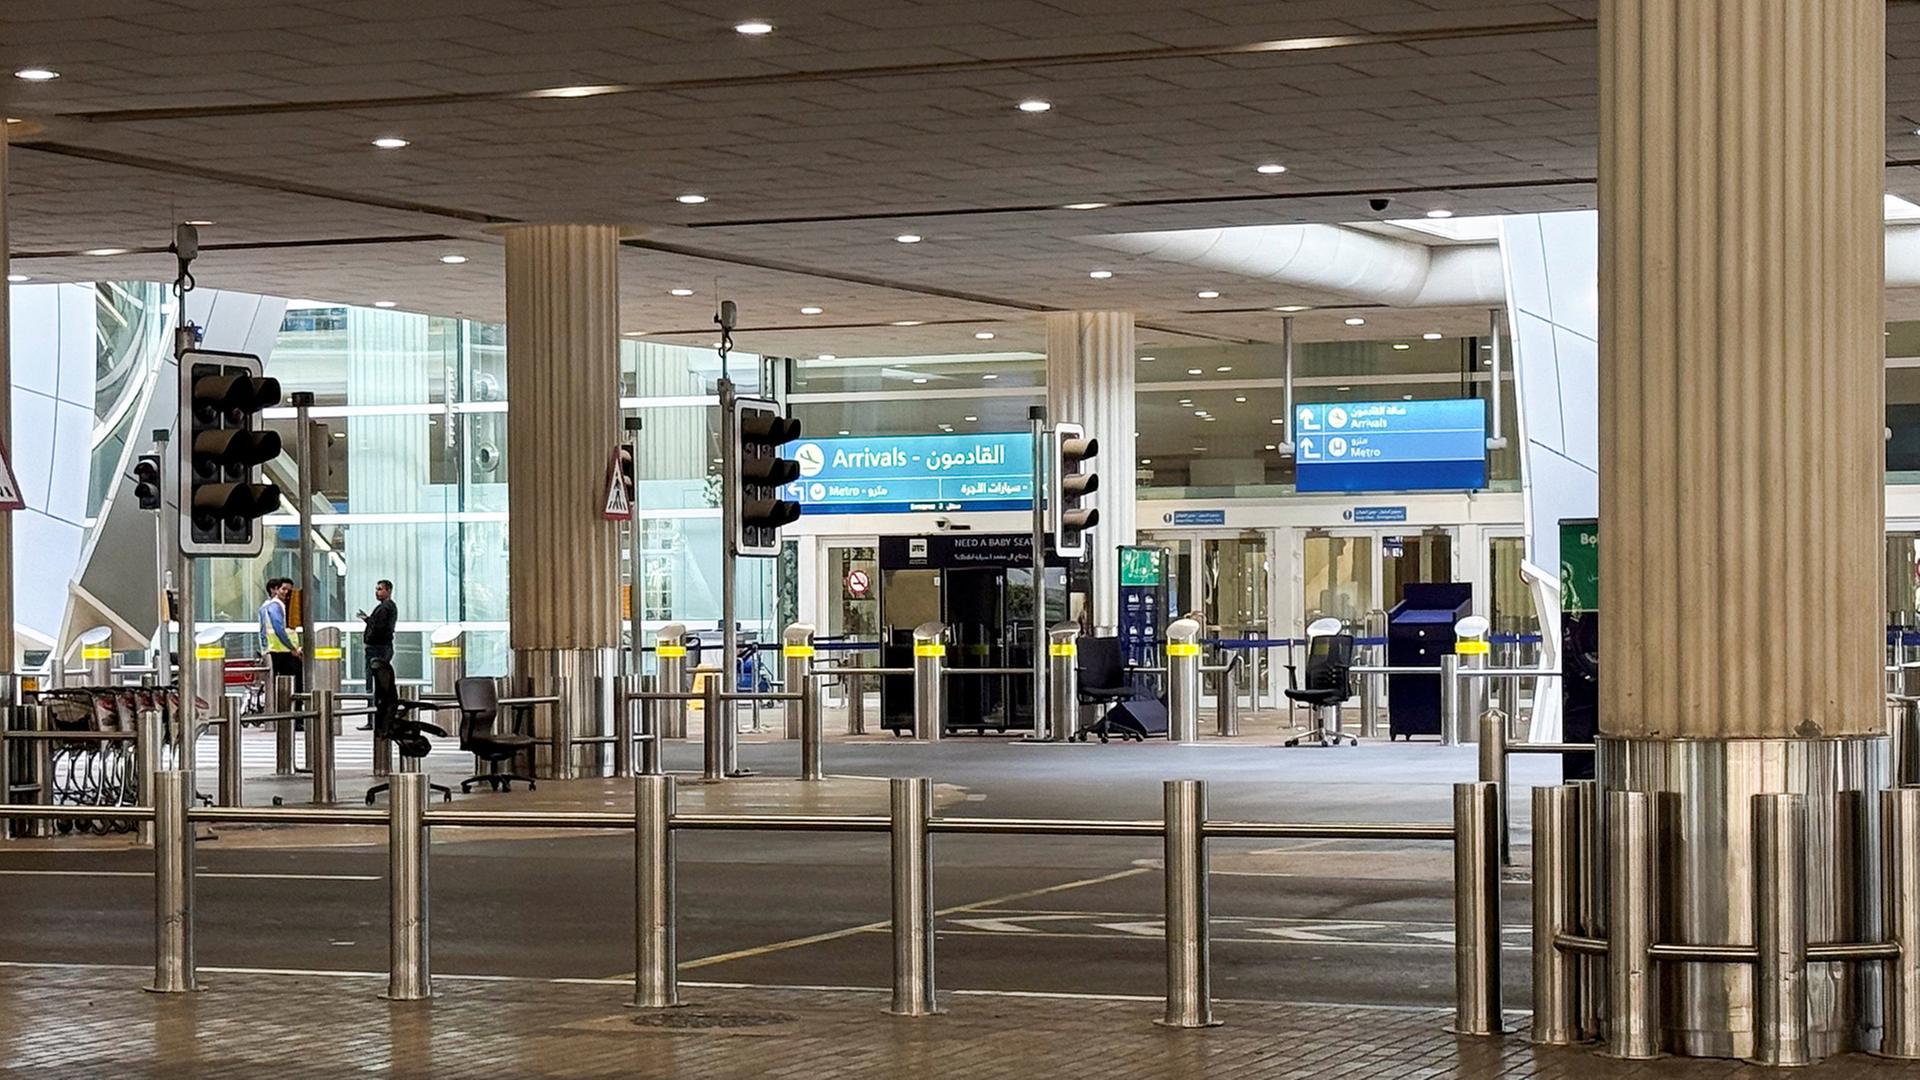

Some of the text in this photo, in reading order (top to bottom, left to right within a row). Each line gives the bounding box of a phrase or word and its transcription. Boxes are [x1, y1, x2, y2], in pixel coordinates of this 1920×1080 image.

[1351, 418, 1387, 428] Arrivals
[832, 446, 907, 468] Arrivals
[926, 444, 1004, 470] القادمون
[1351, 447, 1381, 457] Metro
[829, 486, 860, 496] Metro
[867, 485, 888, 497] مترو
[954, 538, 978, 547] NEED
[980, 538, 987, 547] A
[989, 538, 1011, 547] BABY
